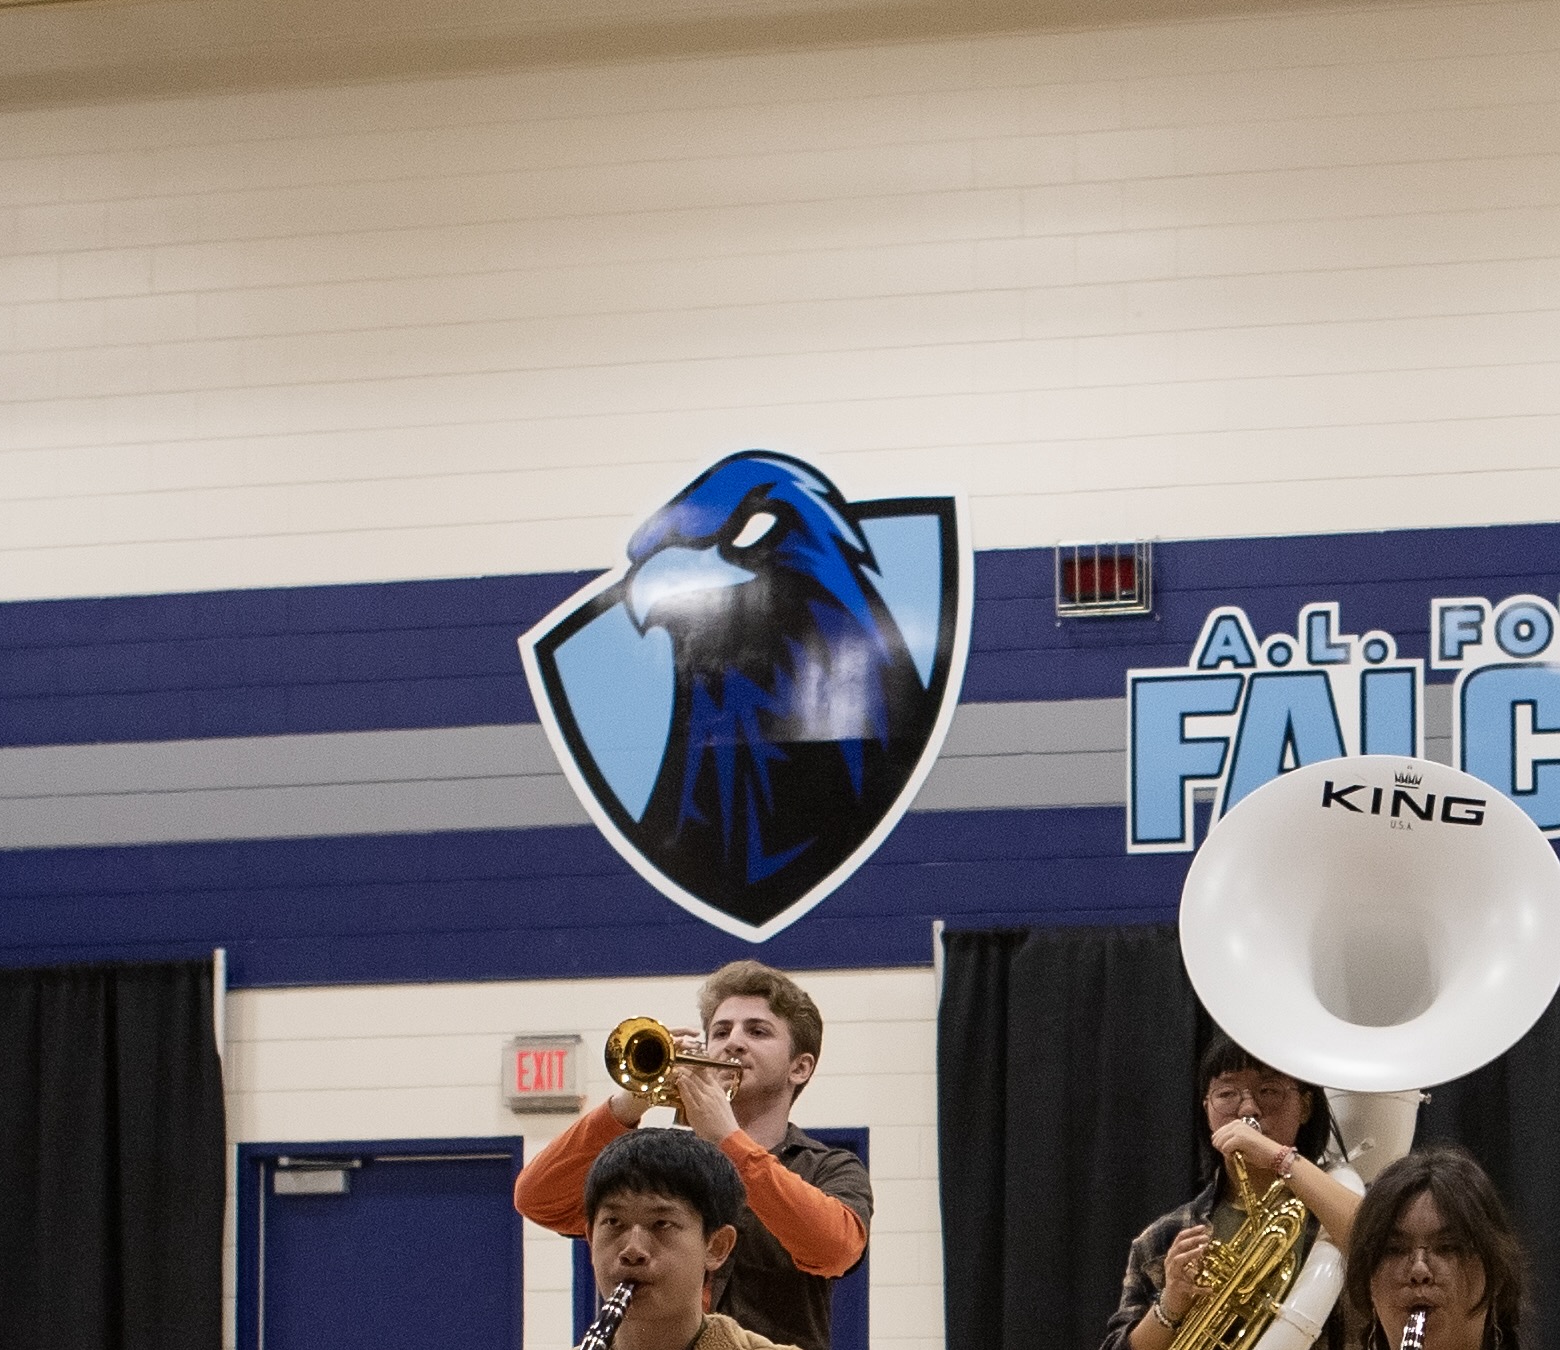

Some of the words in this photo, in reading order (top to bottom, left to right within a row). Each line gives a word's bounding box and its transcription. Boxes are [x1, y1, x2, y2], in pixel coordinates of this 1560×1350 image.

[1198, 609, 1389, 669] A.L.
[1322, 780, 1487, 826] KING
[516, 1050, 567, 1092] EXIT
